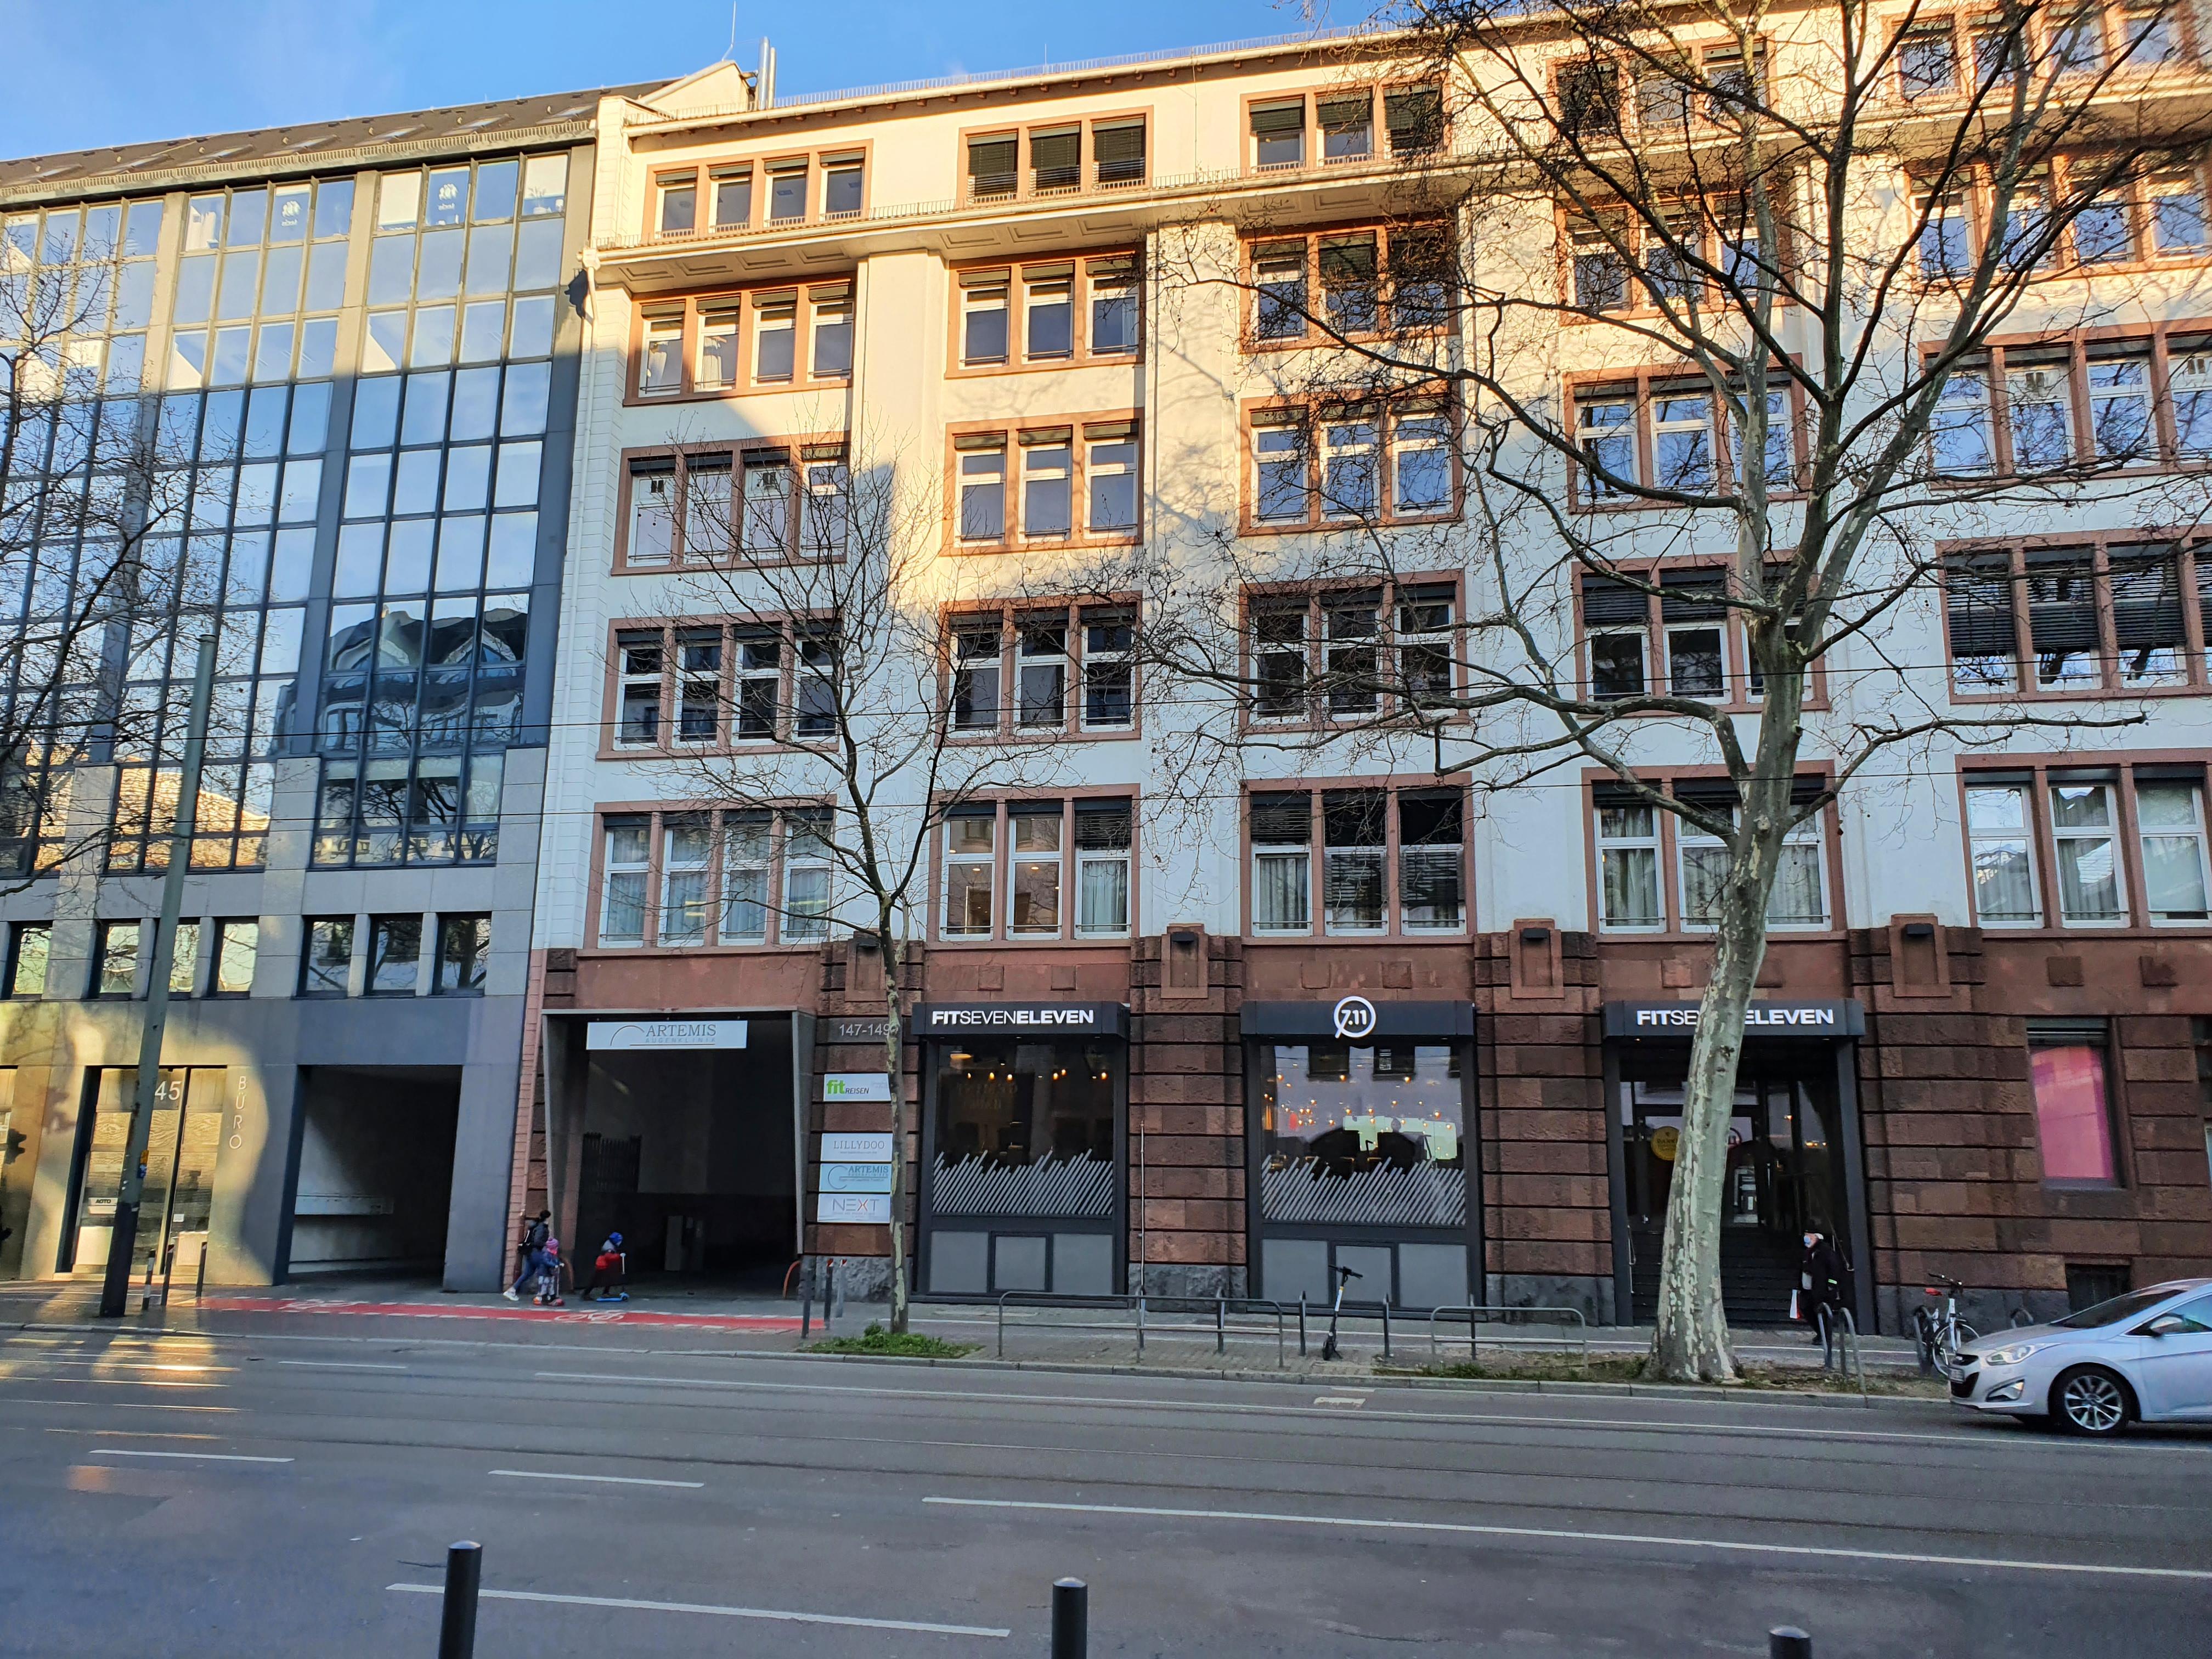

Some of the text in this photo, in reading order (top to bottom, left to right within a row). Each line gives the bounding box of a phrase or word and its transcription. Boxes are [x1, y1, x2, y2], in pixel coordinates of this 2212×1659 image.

[932, 1010, 1093, 1024] FITSEVENELEVEN
[1637, 1009, 1834, 1025] FITSEELEVEN
[646, 1024, 716, 1037] ARTEMIS
[839, 1024, 890, 1036] 147-149
[827, 1080, 845, 1094] fit
[229, 1076, 246, 1149] BÜRO
[834, 1141, 885, 1149] LILLYDOO
[833, 1198, 879, 1211] NEXT
